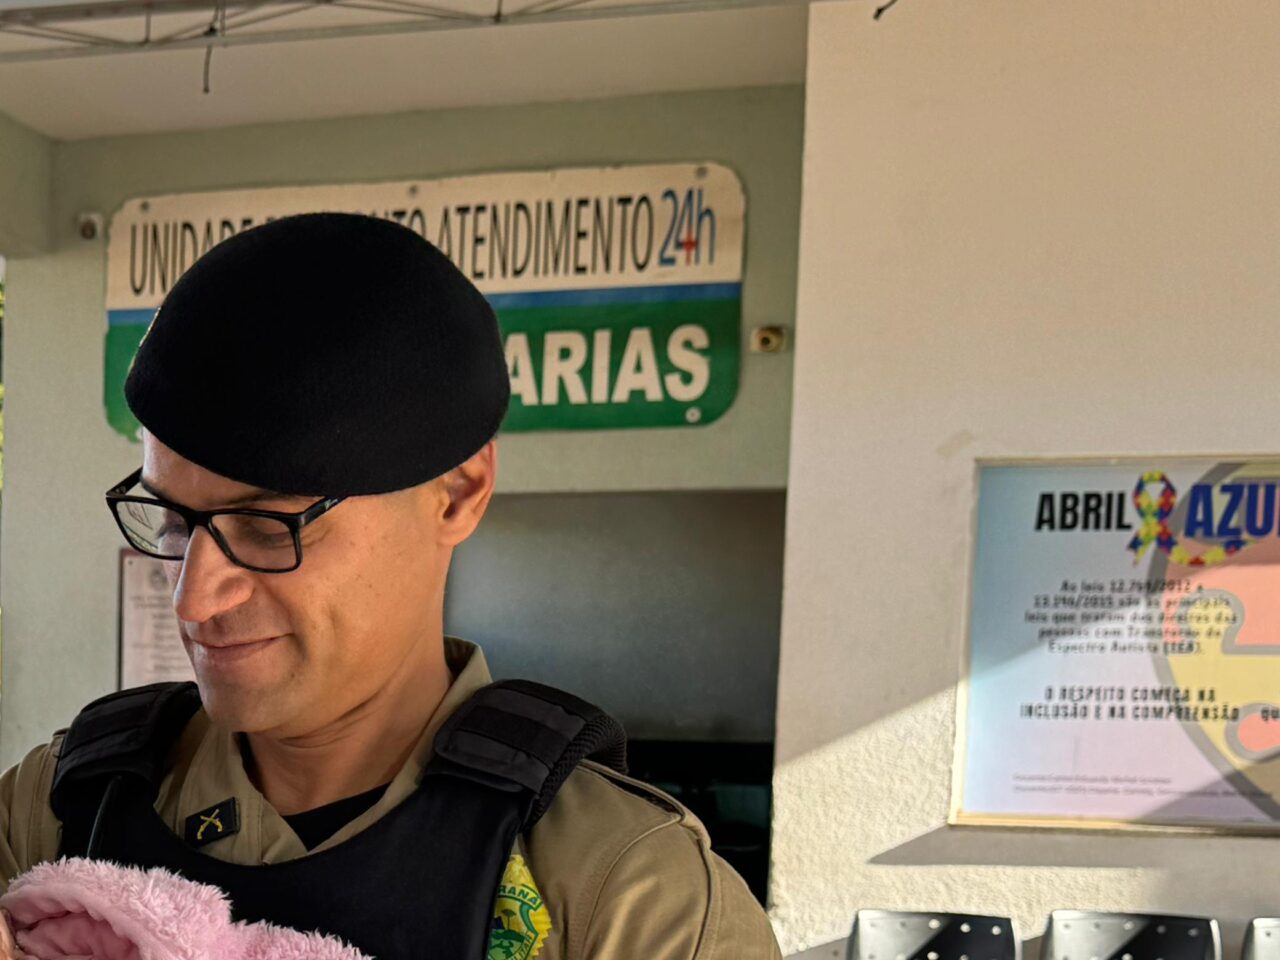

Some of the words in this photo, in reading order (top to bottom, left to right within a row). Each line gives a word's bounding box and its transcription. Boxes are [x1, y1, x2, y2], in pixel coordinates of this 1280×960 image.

[437, 193, 655, 280] ATENDIMENTO
[657, 186, 717, 266] 24h
[1035, 491, 1133, 531] ABRIL
